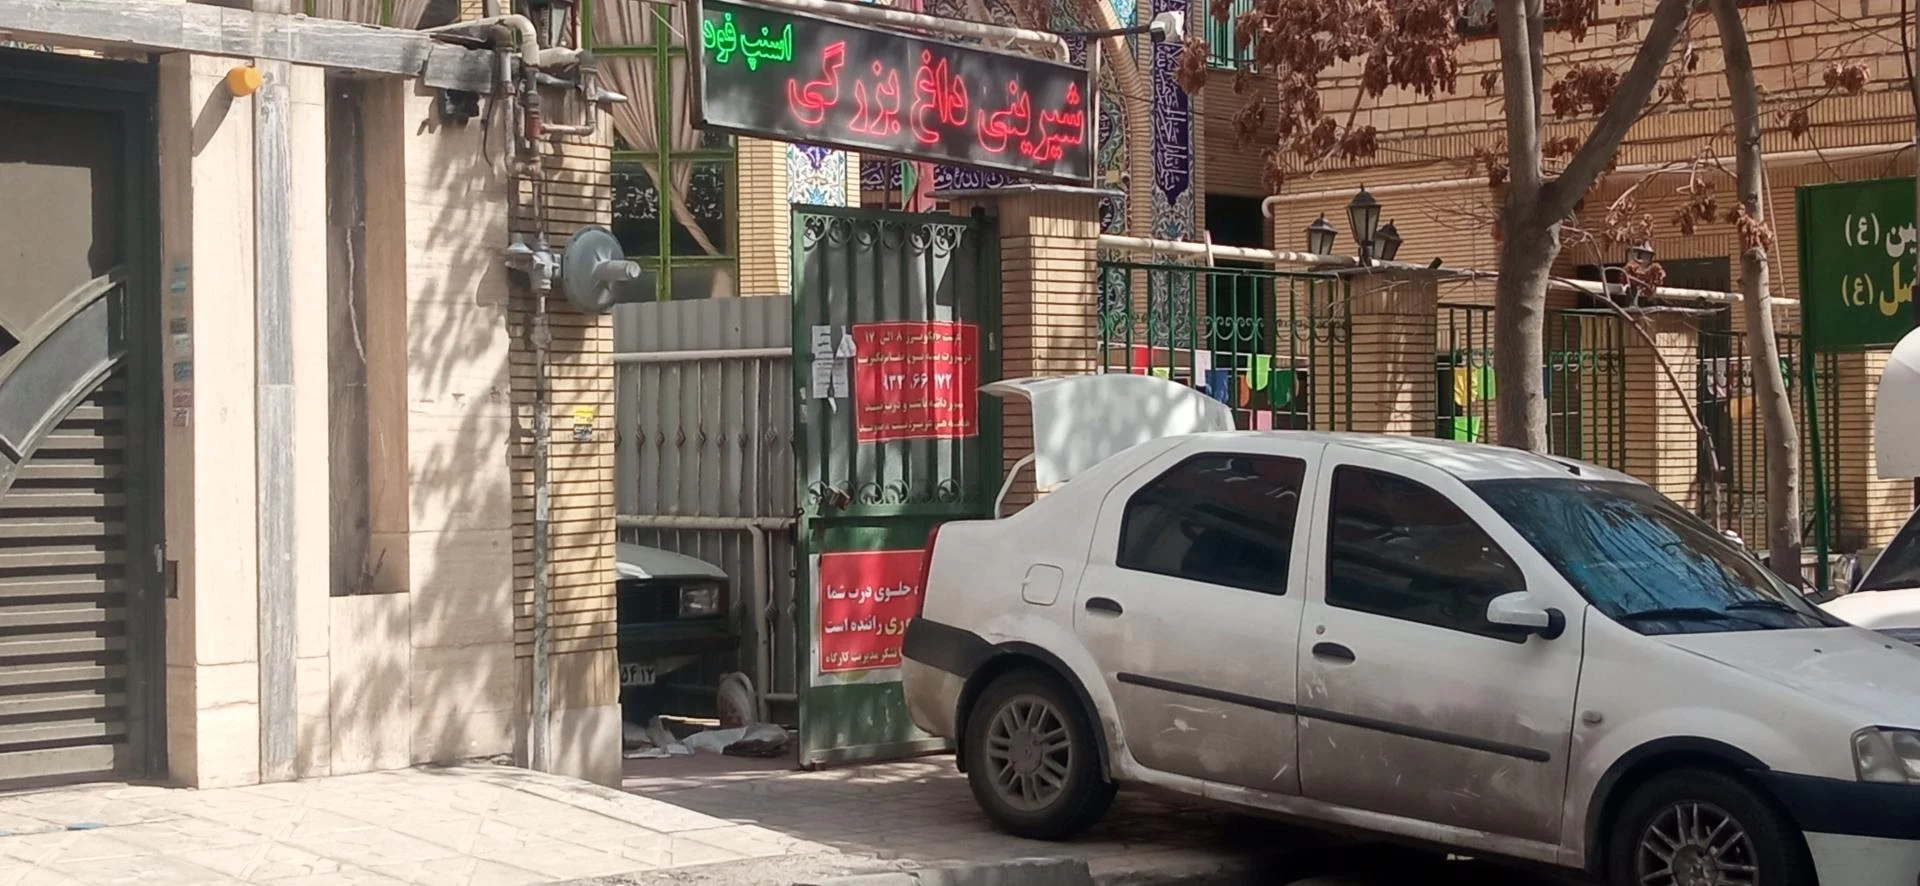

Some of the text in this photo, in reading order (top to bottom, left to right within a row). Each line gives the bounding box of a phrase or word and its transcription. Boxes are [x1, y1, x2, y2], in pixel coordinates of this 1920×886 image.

[702, 12, 793, 71] اسنپ فود
[786, 41, 1085, 162] شیرینی داغ بزرگی
[1844, 212, 1917, 258] ین (ع)
[1841, 273, 1874, 307] (ع)
[827, 581, 912, 604] جلوی درب شما
[824, 617, 849, 634] است
[850, 615, 882, 635] راننده
[825, 650, 849, 667] کارگاه
